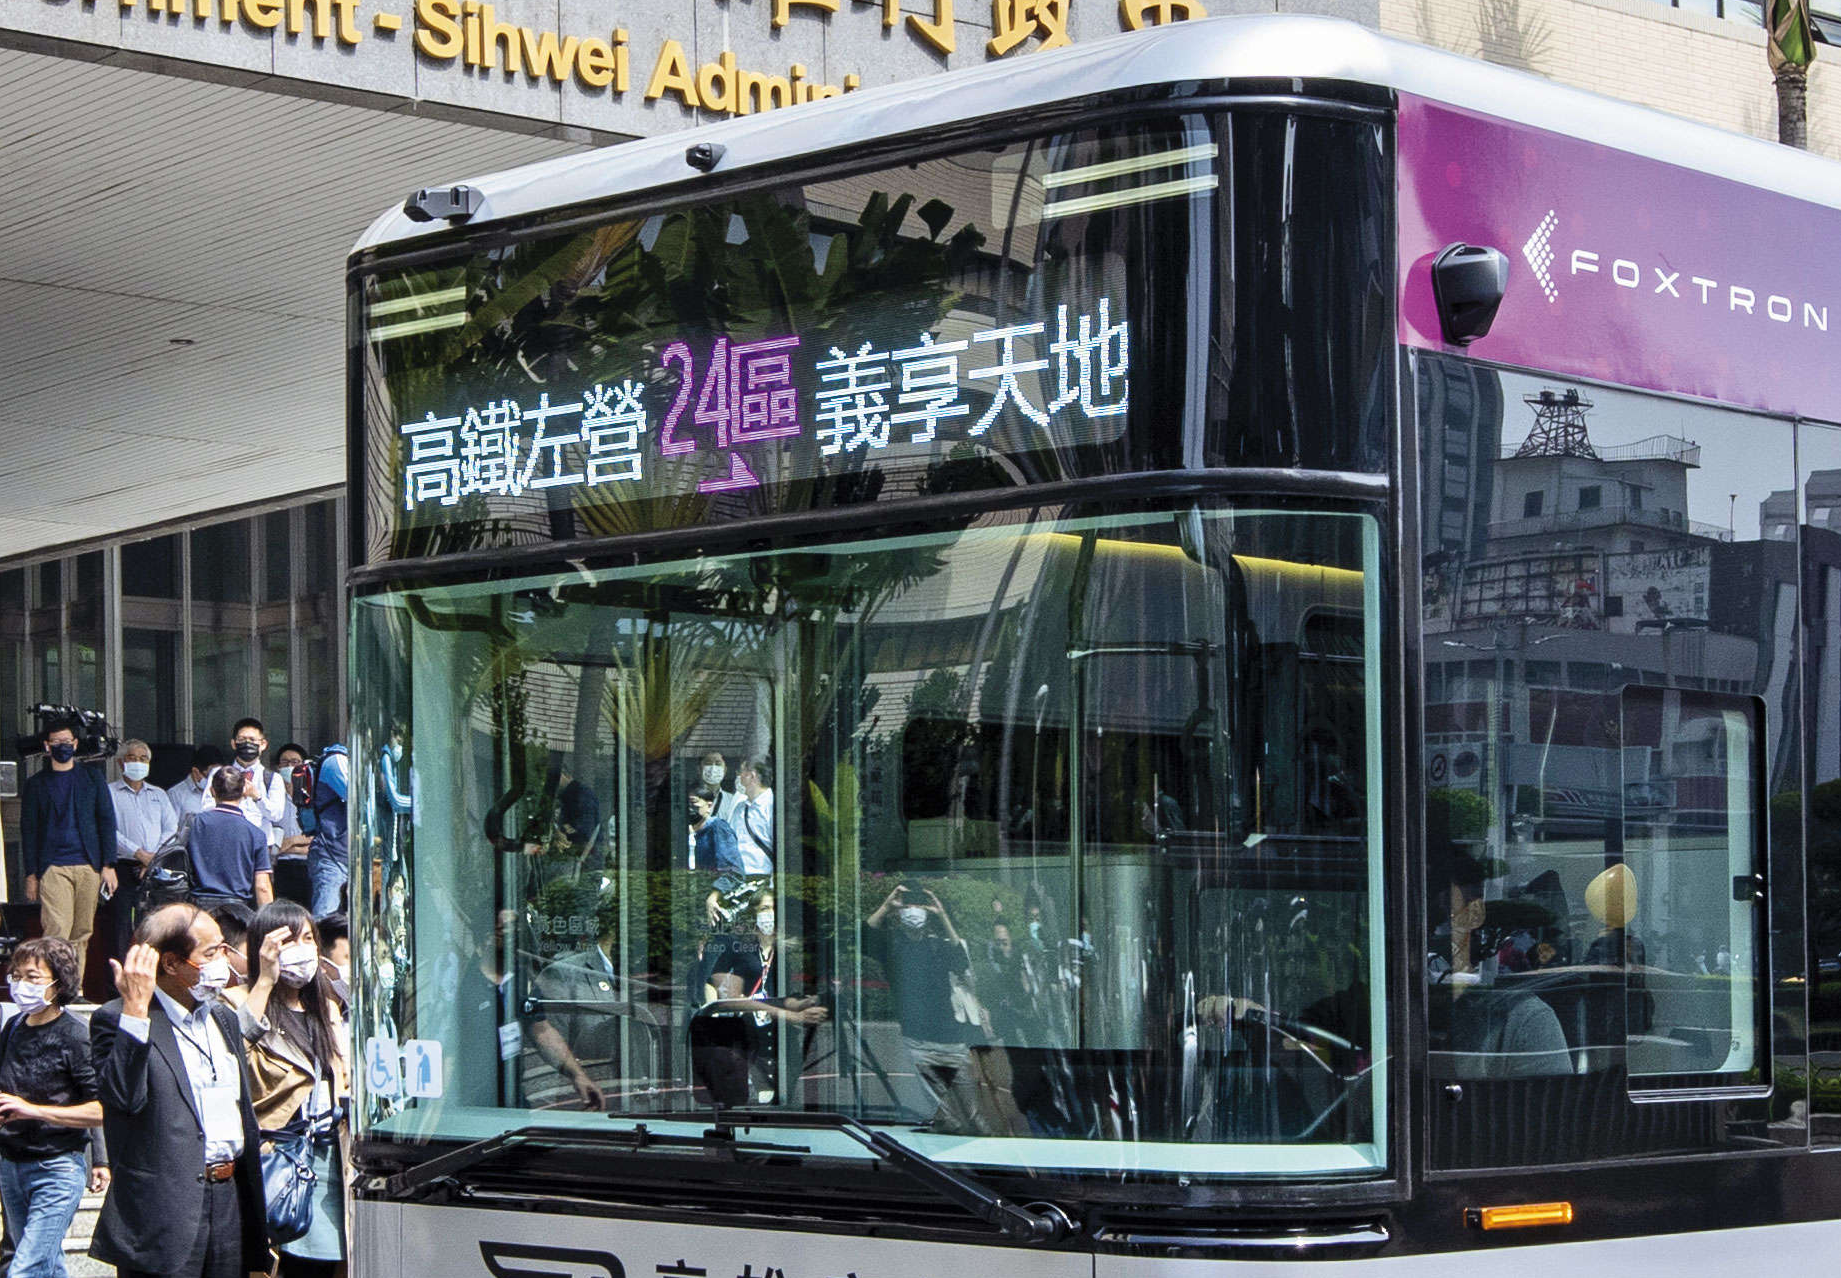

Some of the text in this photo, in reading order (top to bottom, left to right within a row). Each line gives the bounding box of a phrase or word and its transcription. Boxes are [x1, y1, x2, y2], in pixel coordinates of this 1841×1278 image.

[1571, 248, 1828, 332] FOXTRON
[400, 297, 1130, 511] 高鐵左營 24區 義享天地
